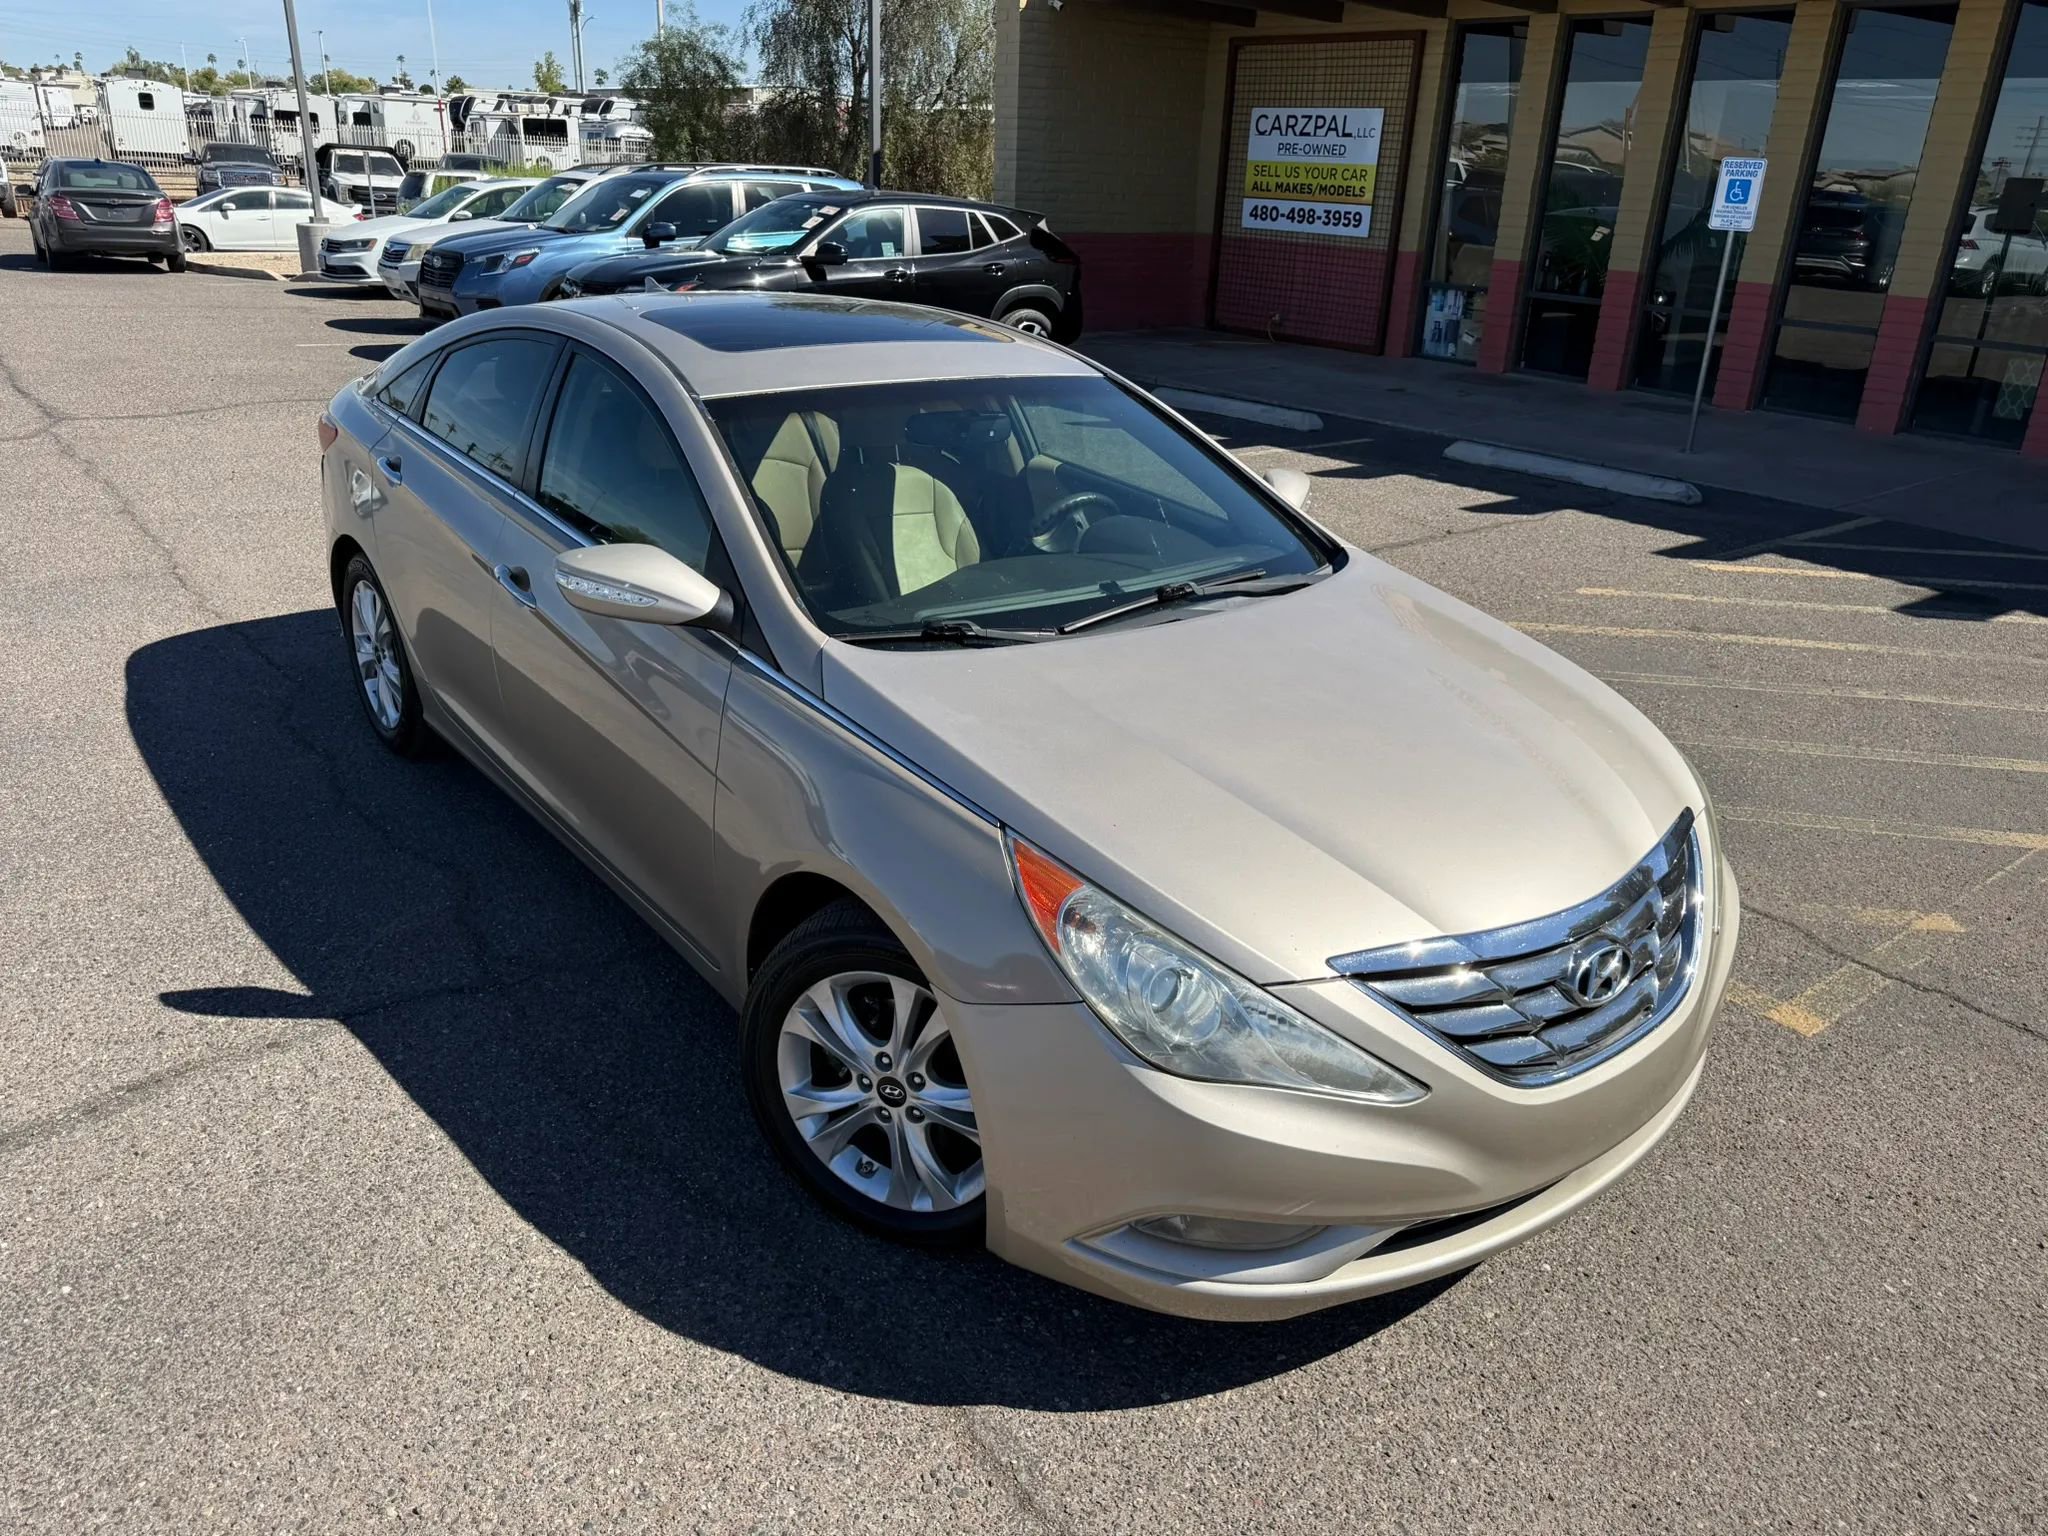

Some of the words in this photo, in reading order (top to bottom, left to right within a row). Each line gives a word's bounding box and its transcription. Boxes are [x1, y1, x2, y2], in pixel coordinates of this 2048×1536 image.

[1277, 142, 1347, 157] PRE-OWNED
[1253, 164, 1280, 178] SELL
[1284, 166, 1300, 179] US
[1304, 167, 1337, 181] YOUR
[1341, 168, 1368, 182] CAR
[1724, 161, 1763, 170] RESERVED
[1725, 170, 1759, 178] PARKING
[1251, 181, 1272, 193] ALL
[1274, 182, 1366, 198] MAKES/MODELS
[1249, 205, 1363, 229] 480-498-3959
